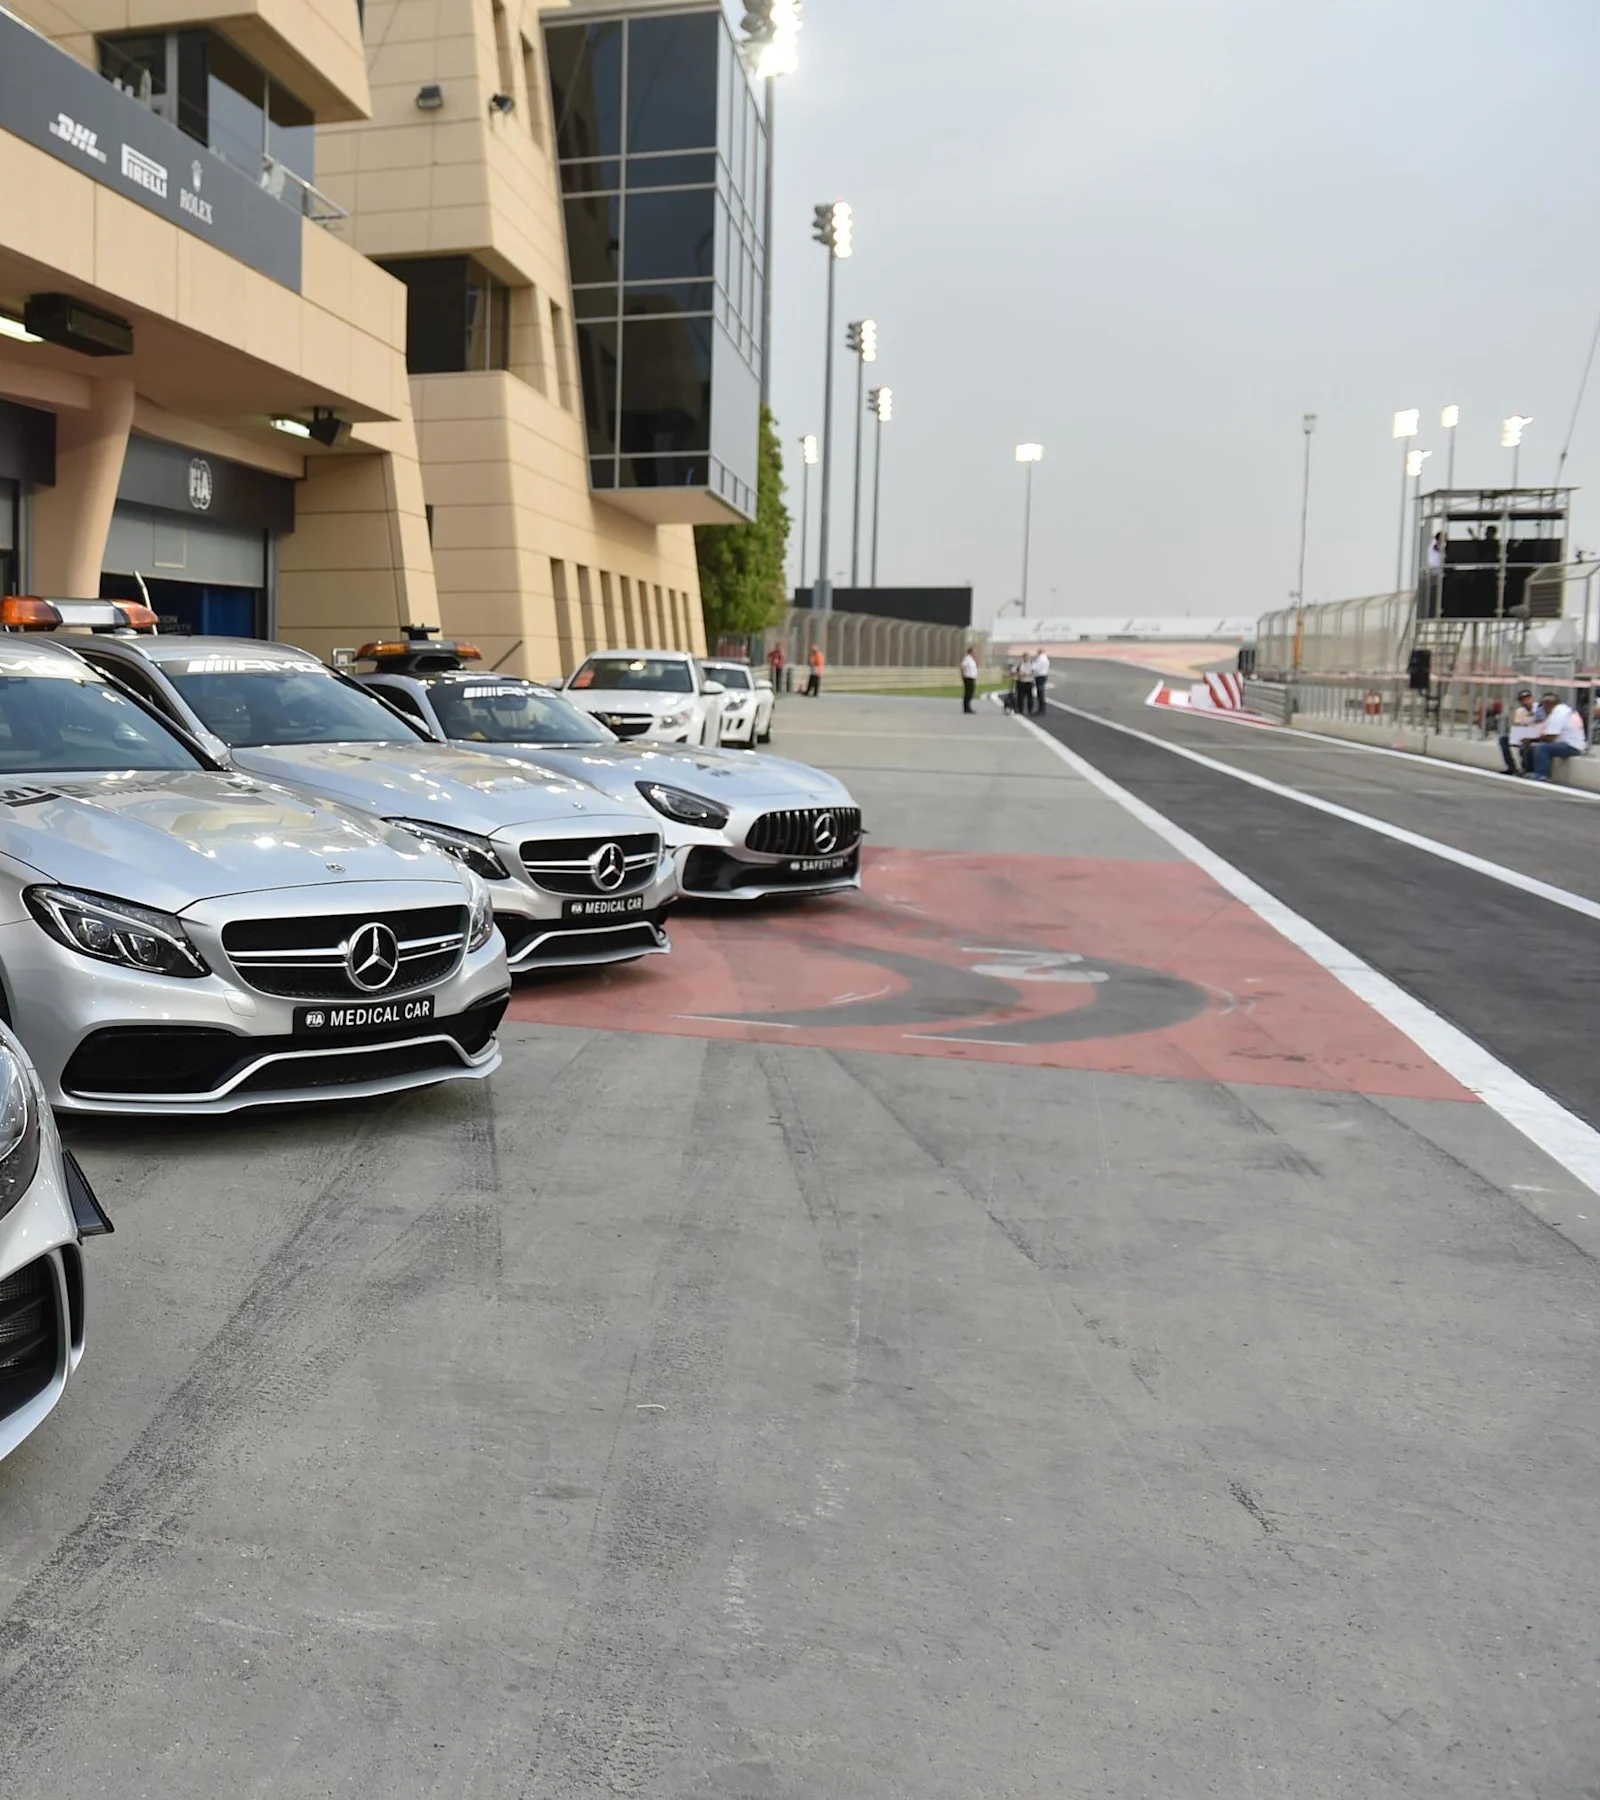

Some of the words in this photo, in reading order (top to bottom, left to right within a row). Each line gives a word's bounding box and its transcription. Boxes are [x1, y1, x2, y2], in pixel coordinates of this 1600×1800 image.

[55, 112, 102, 159] DHL
[121, 143, 168, 199] PIRELLI
[179, 188, 214, 225] ROLEX
[585, 900, 626, 914] MEDICAL
[627, 896, 642, 911] CAR
[330, 1005, 400, 1027] MEDICAL
[404, 1000, 430, 1019] CAR
